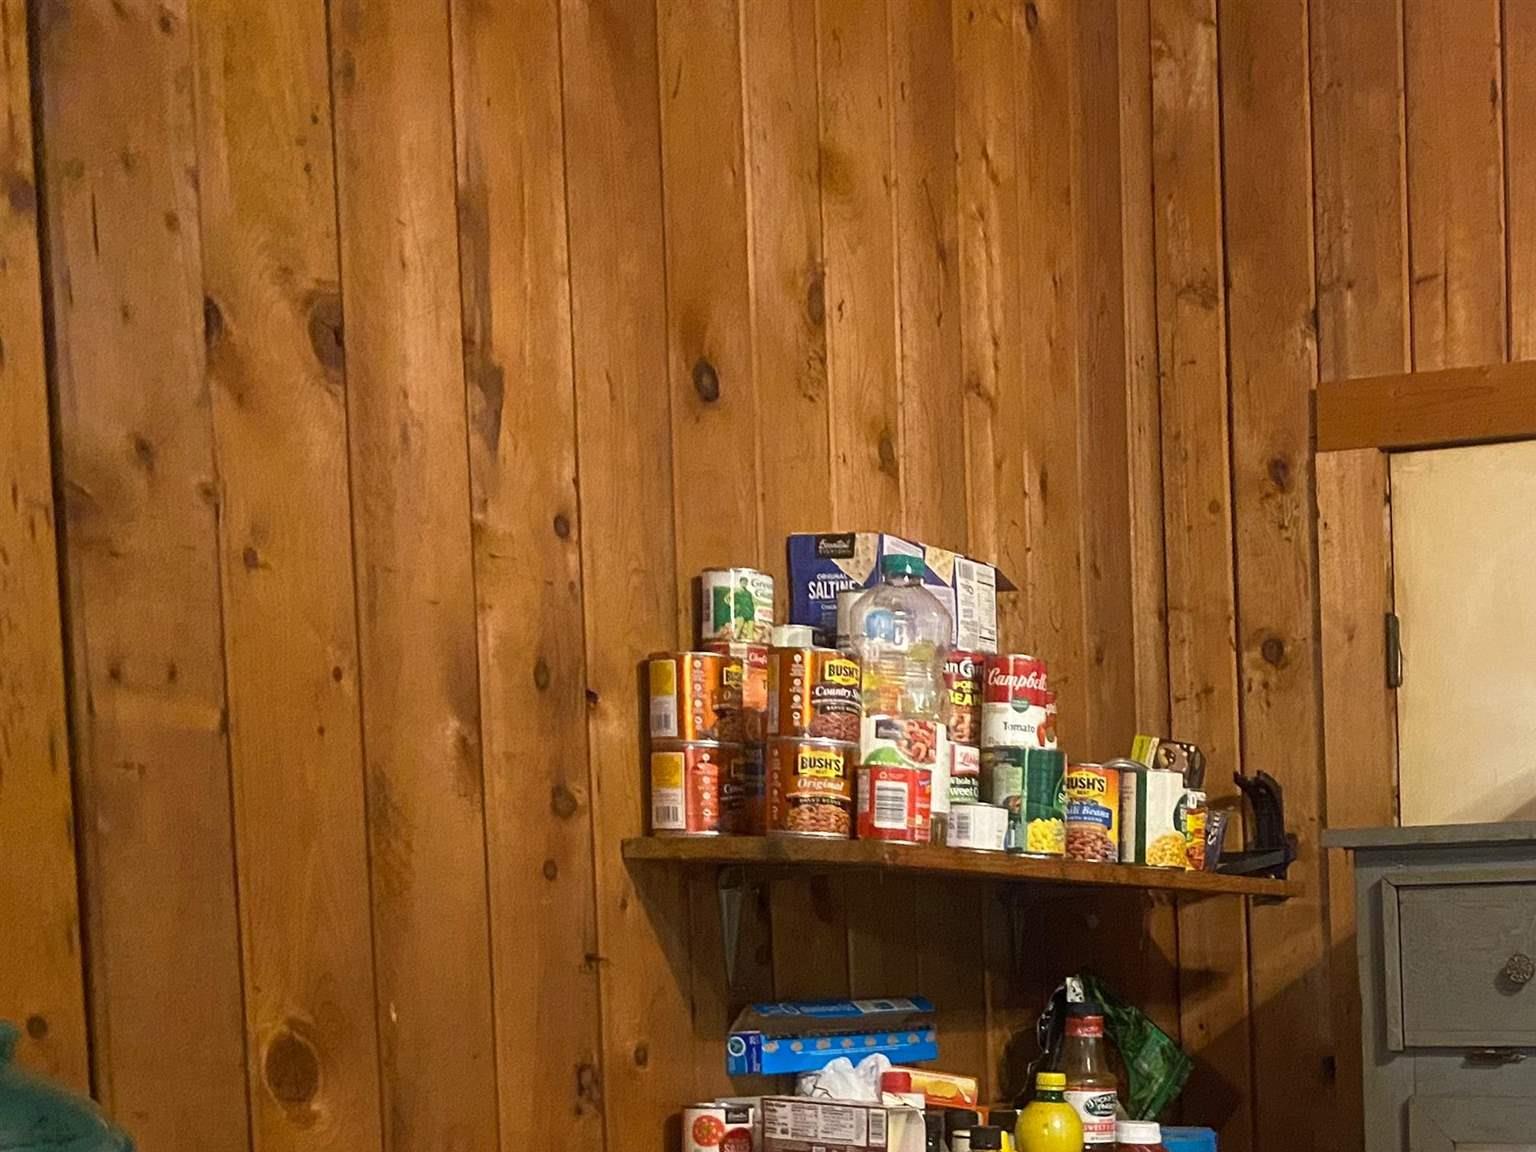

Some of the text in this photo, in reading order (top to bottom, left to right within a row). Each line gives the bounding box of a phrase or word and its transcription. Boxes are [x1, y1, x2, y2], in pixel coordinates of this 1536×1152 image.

[828, 664, 861, 679] BUSH'S
[815, 686, 851, 698] Country
[800, 756, 841, 771] BUSH'S
[798, 779, 845, 792] Original
